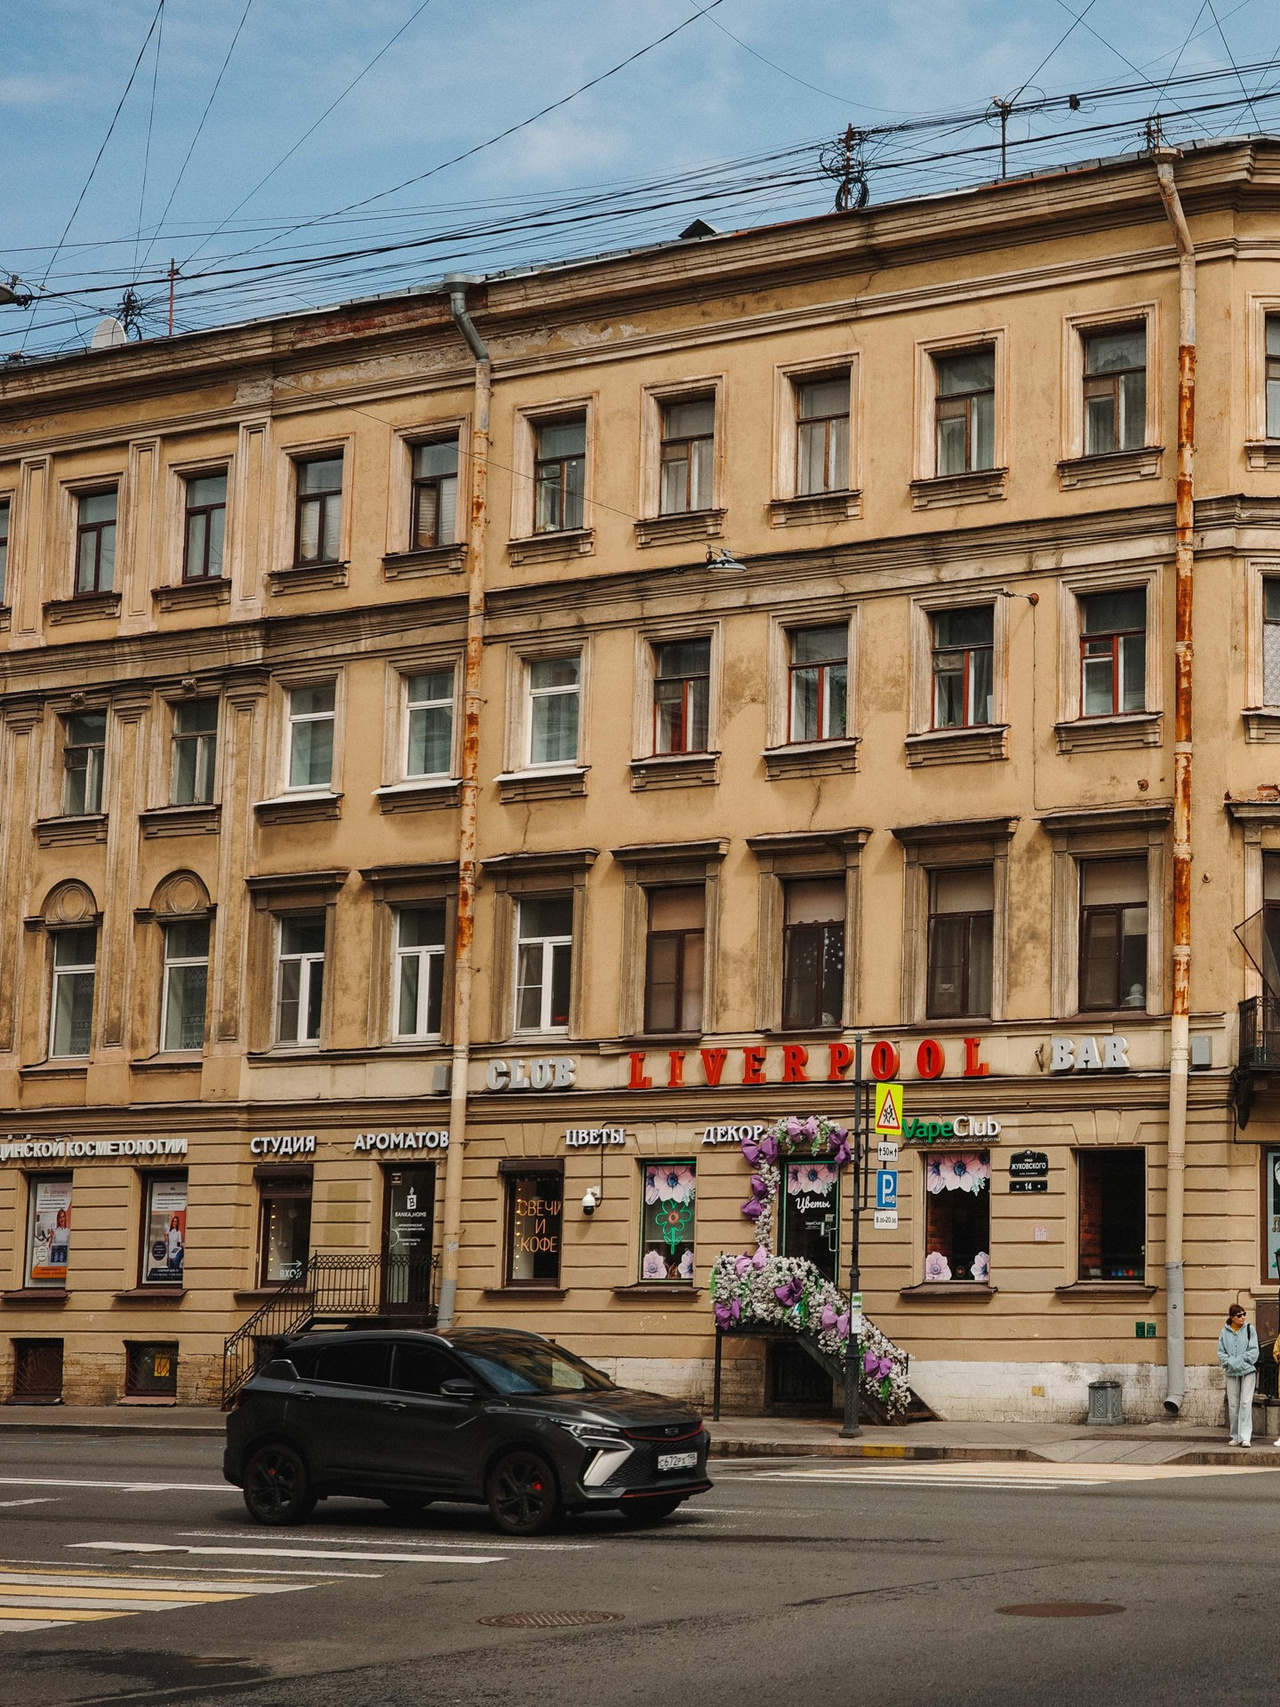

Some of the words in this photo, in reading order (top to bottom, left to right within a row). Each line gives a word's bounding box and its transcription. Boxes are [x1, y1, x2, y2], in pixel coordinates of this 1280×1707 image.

[486, 1057, 576, 1090] CLUB
[627, 1038, 989, 1089] LIVERPOOL
[1050, 1036, 1130, 1071] BAR
[565, 1128, 626, 1146] ЦВЕТЫ
[701, 1125, 763, 1144] ДЕКОР
[902, 1116, 1001, 1143] VapeClub
[66, 1138, 188, 1157] КОСМЕТОЛОГИИ
[250, 1135, 316, 1154] СТУДИЯ
[353, 1131, 449, 1150] АРОМАТОВ
[1011, 1162, 1046, 1170] ЖУКОВСКОГО
[1024, 1182, 1032, 1190] 14
[518, 1199, 561, 1216] СВЕЧИ
[795, 1196, 831, 1213] Цветы
[535, 1218, 546, 1234] И
[520, 1236, 558, 1252] КОФЕ
